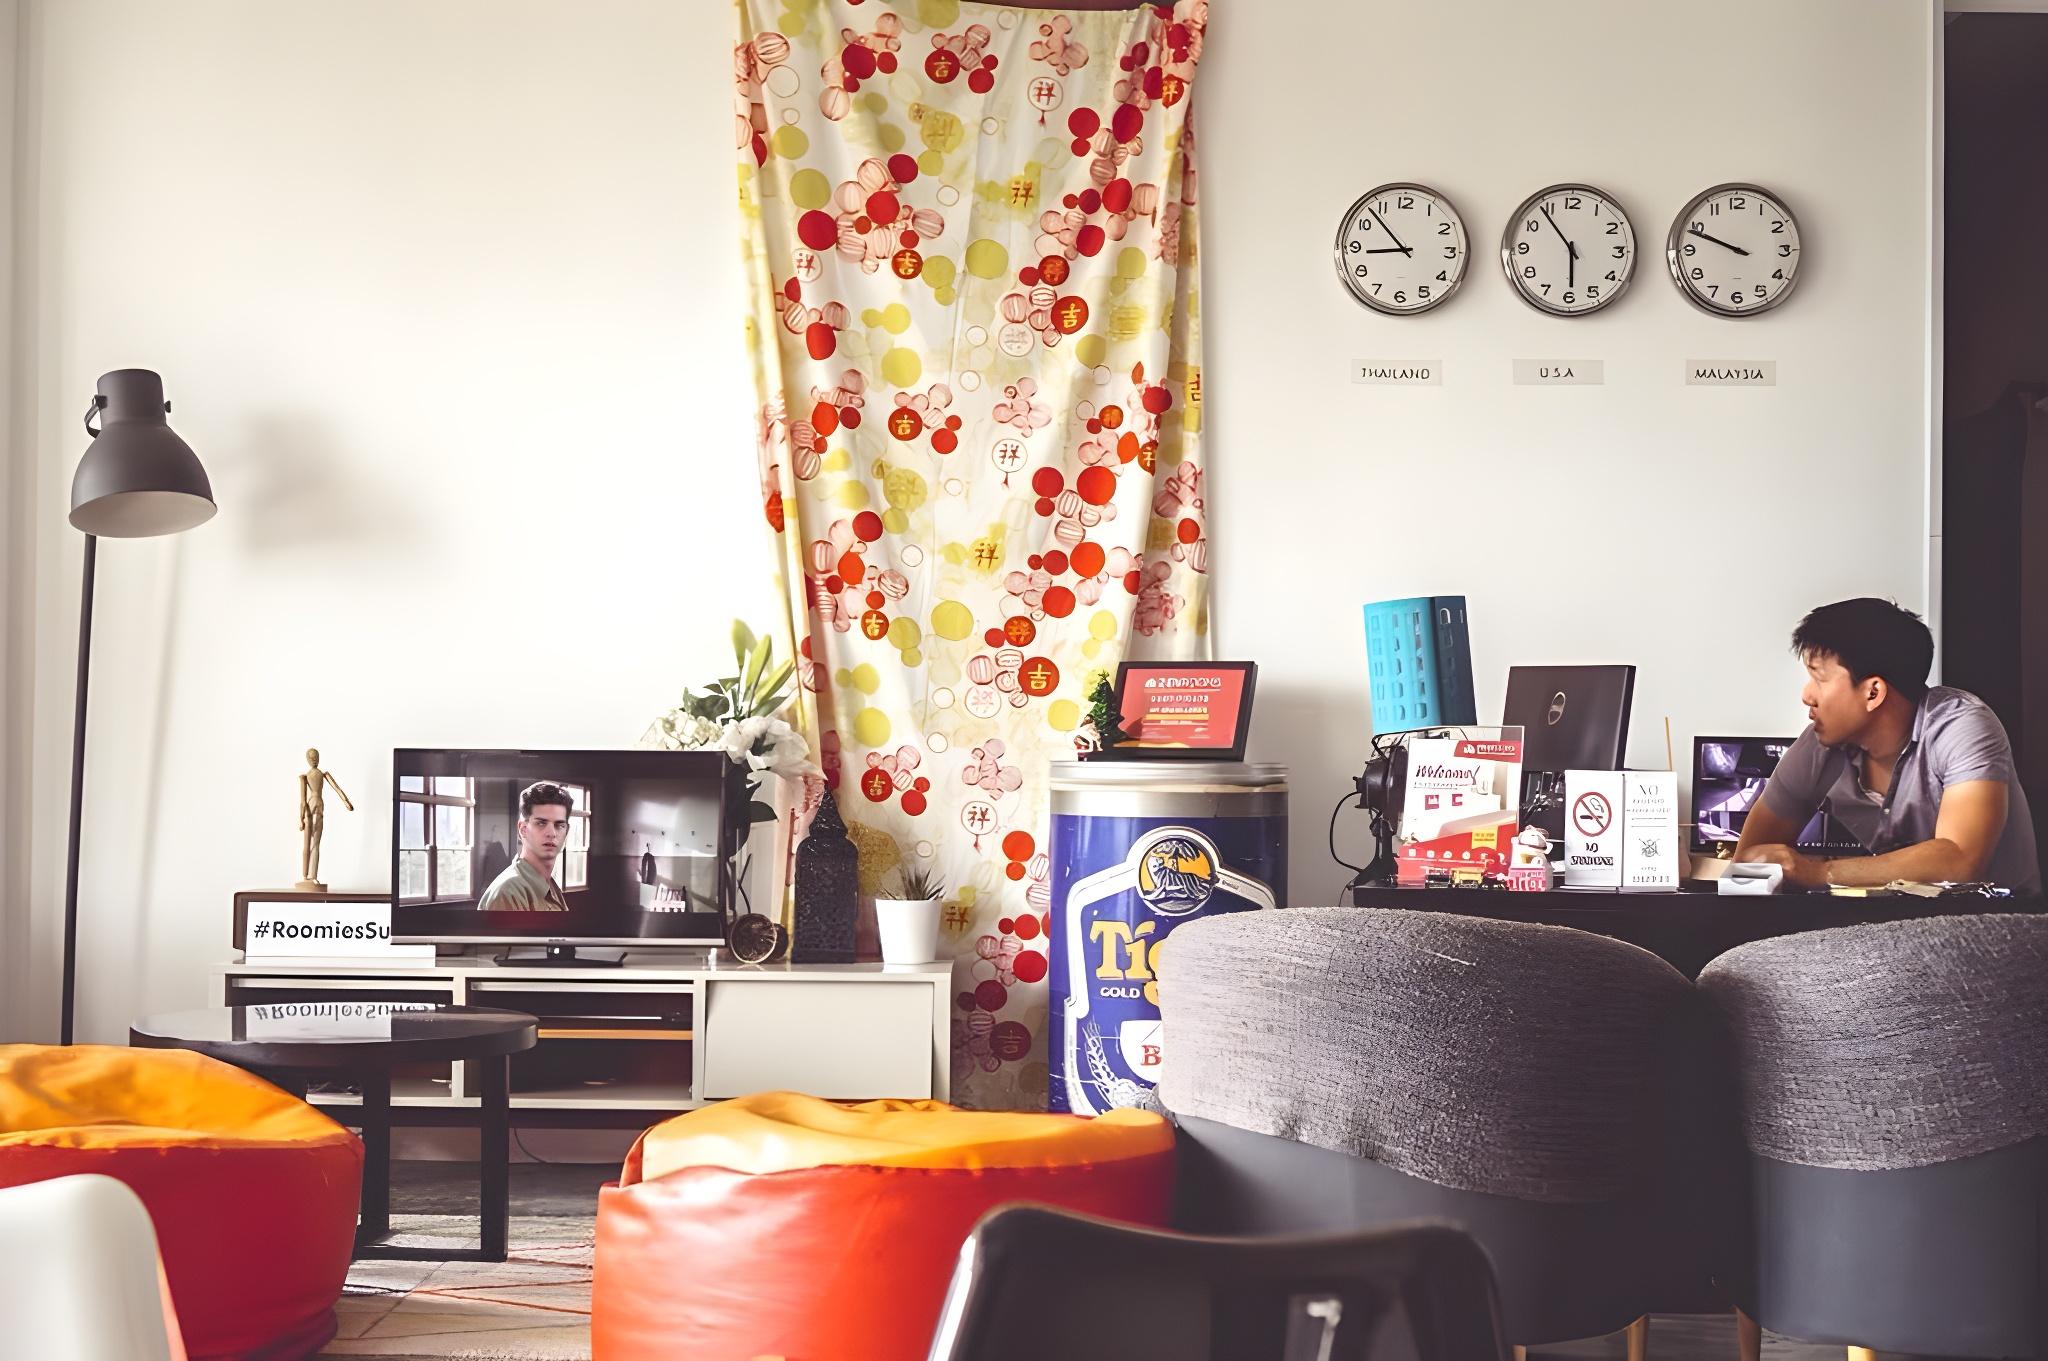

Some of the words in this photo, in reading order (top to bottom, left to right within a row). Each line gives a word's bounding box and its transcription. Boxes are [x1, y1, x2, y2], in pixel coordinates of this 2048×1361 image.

[1378, 202, 1388, 214] 11
[1398, 197, 1414, 209] 12
[1545, 202, 1555, 215] 11
[1565, 198, 1581, 209] 12
[1730, 198, 1745, 210] 12
[1710, 204, 1720, 216] 11
[1359, 219, 1371, 230] 10
[1438, 223, 1451, 235] 2
[1527, 220, 1538, 232] 10
[1606, 222, 1618, 234] 2
[1771, 221, 1784, 233] 2
[1350, 241, 1361, 253] 9
[1444, 247, 1456, 259] 3
[1518, 242, 1529, 254] 9
[1612, 246, 1625, 258] 3
[1683, 244, 1696, 256] 9
[1778, 245, 1790, 257] 3
[1355, 265, 1367, 277] 8
[1436, 270, 1448, 281] 4
[1524, 266, 1536, 278] 8
[1605, 271, 1616, 281] 4
[1691, 268, 1703, 280] 8
[1772, 269, 1783, 280] 4
[1372, 284, 1382, 295] 7
[1419, 286, 1430, 298] 5
[1541, 284, 1551, 295] 7
[1587, 286, 1599, 298] 5
[1707, 286, 1718, 298] 7
[1754, 285, 1767, 297] 5
[1394, 291, 1406, 303] 6
[1563, 292, 1575, 303] 6
[1731, 292, 1743, 304] 6
[1060, 303, 1081, 328] 吉
[1027, 663, 1051, 690] 吉
[967, 806, 990, 830] 祥
[1100, 987, 1141, 999] GOLD
